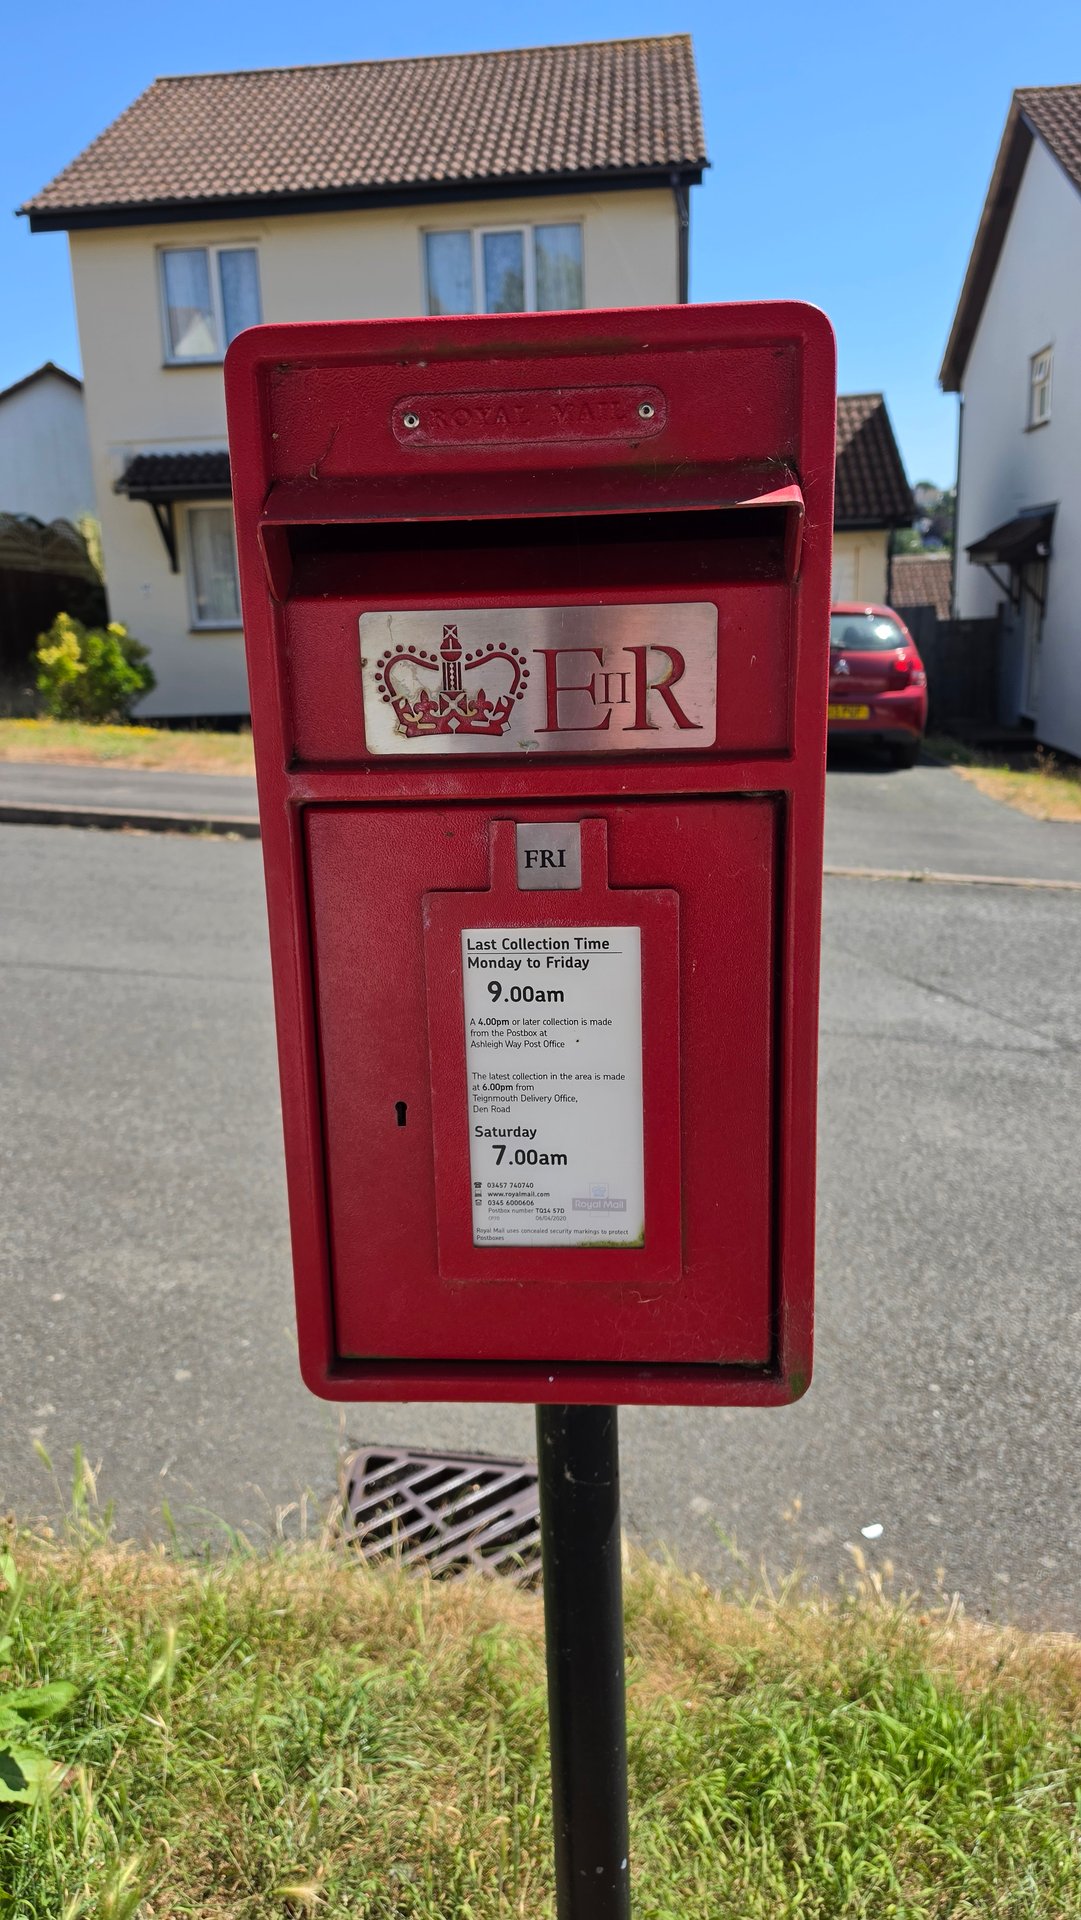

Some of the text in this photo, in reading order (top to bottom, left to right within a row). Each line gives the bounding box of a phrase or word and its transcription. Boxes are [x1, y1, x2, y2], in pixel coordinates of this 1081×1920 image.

[428, 400, 628, 428] ROYAL MAIL
[524, 850, 566, 868] FRI
[467, 937, 610, 950] Last Collection Time
[467, 955, 590, 970] Monday to Friday
[487, 980, 565, 1003] 9.00am
[470, 1018, 476, 1026] A
[478, 1018, 510, 1028] 4.00pm
[522, 1018, 541, 1026] later
[542, 1017, 579, 1026] collection
[581, 1018, 588, 1026] is
[589, 1017, 613, 1026] made
[470, 1029, 548, 1037] from the Postbox at
[470, 1039, 566, 1050] Ashleigh Way Post Office
[472, 1072, 487, 1081] The
[489, 1072, 510, 1081] latest
[512, 1072, 548, 1081] collection
[550, 1072, 558, 1080] in
[560, 1072, 573, 1080] the
[594, 1072, 601, 1080] is
[603, 1072, 626, 1081] made
[472, 1082, 535, 1093] at 6.00pm from
[472, 1093, 579, 1104] Teignmouth Delivery Office,
[472, 1105, 511, 1113] Den Road
[474, 1126, 538, 1140] Saturday
[491, 1144, 569, 1166] 7.00am
[487, 1190, 551, 1199] www.royalmail.com
[575, 1200, 624, 1210] Royal Mail
[476, 1227, 492, 1235] Royal
[549, 1227, 572, 1235] security
[573, 1228, 600, 1236] markings
[608, 1228, 629, 1236] protect
